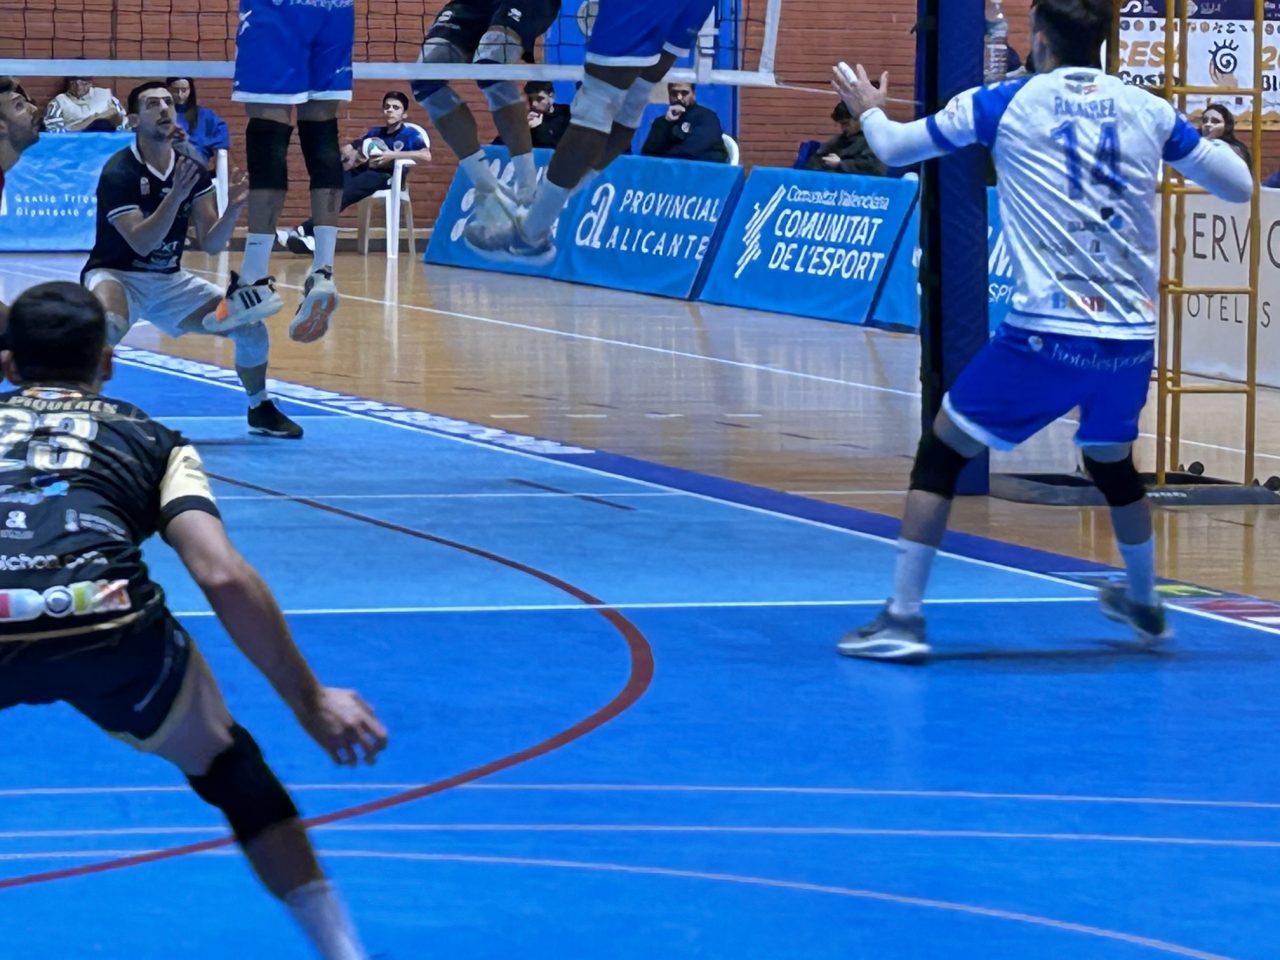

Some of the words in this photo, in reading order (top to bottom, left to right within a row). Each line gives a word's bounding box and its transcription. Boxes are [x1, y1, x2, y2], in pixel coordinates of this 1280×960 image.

[1051, 119, 1124, 200] 14
[620, 189, 719, 223] PROVINCIAL
[606, 226, 711, 260] ALICANTE
[775, 208, 883, 246] COMUNITAT
[768, 242, 791, 270] DE
[796, 248, 884, 281] L'ESPORT
[1187, 293, 1271, 328] OTELS
